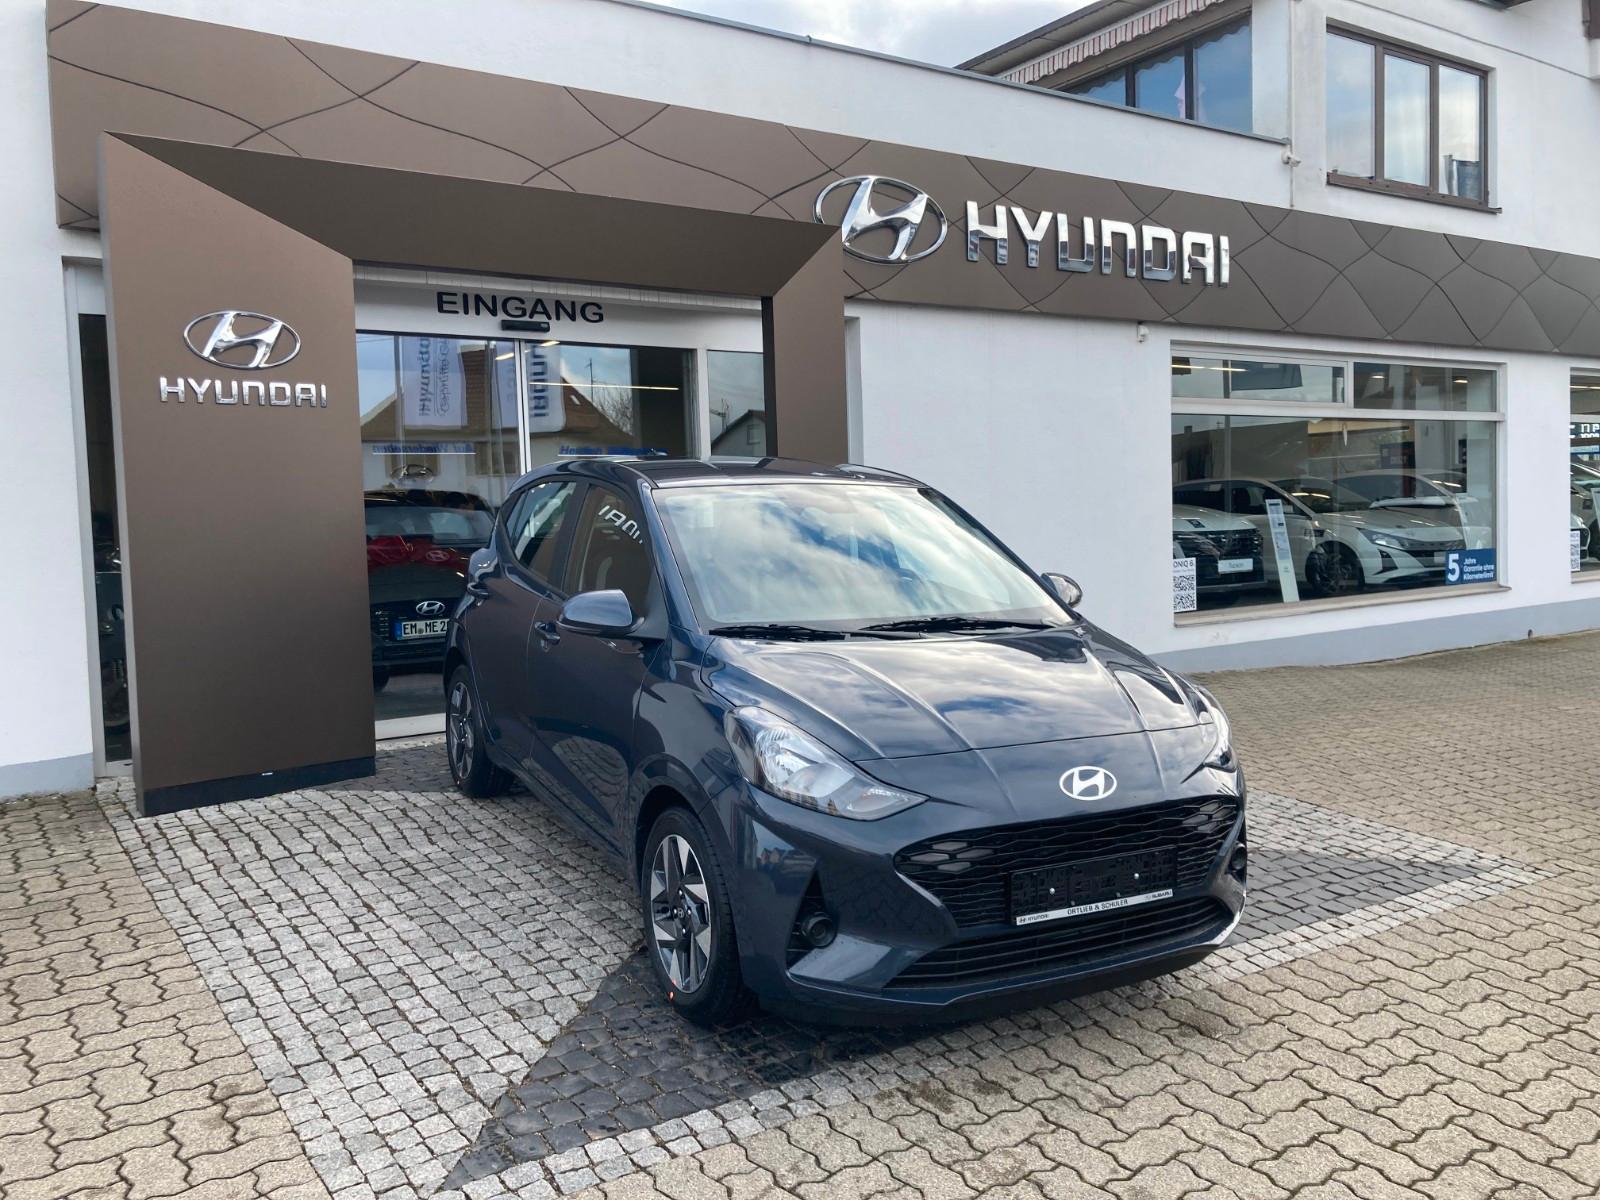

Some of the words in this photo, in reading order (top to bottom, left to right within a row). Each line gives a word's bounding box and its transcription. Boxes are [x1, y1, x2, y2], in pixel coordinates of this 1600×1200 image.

[966, 200, 1230, 288] HYUNDAI
[437, 291, 605, 323] EINGANG
[159, 375, 328, 408] HYUNDAI
[1447, 553, 1460, 582] 5
[1067, 904, 1093, 916] ORTLIEB
[1094, 902, 1100, 911] &
